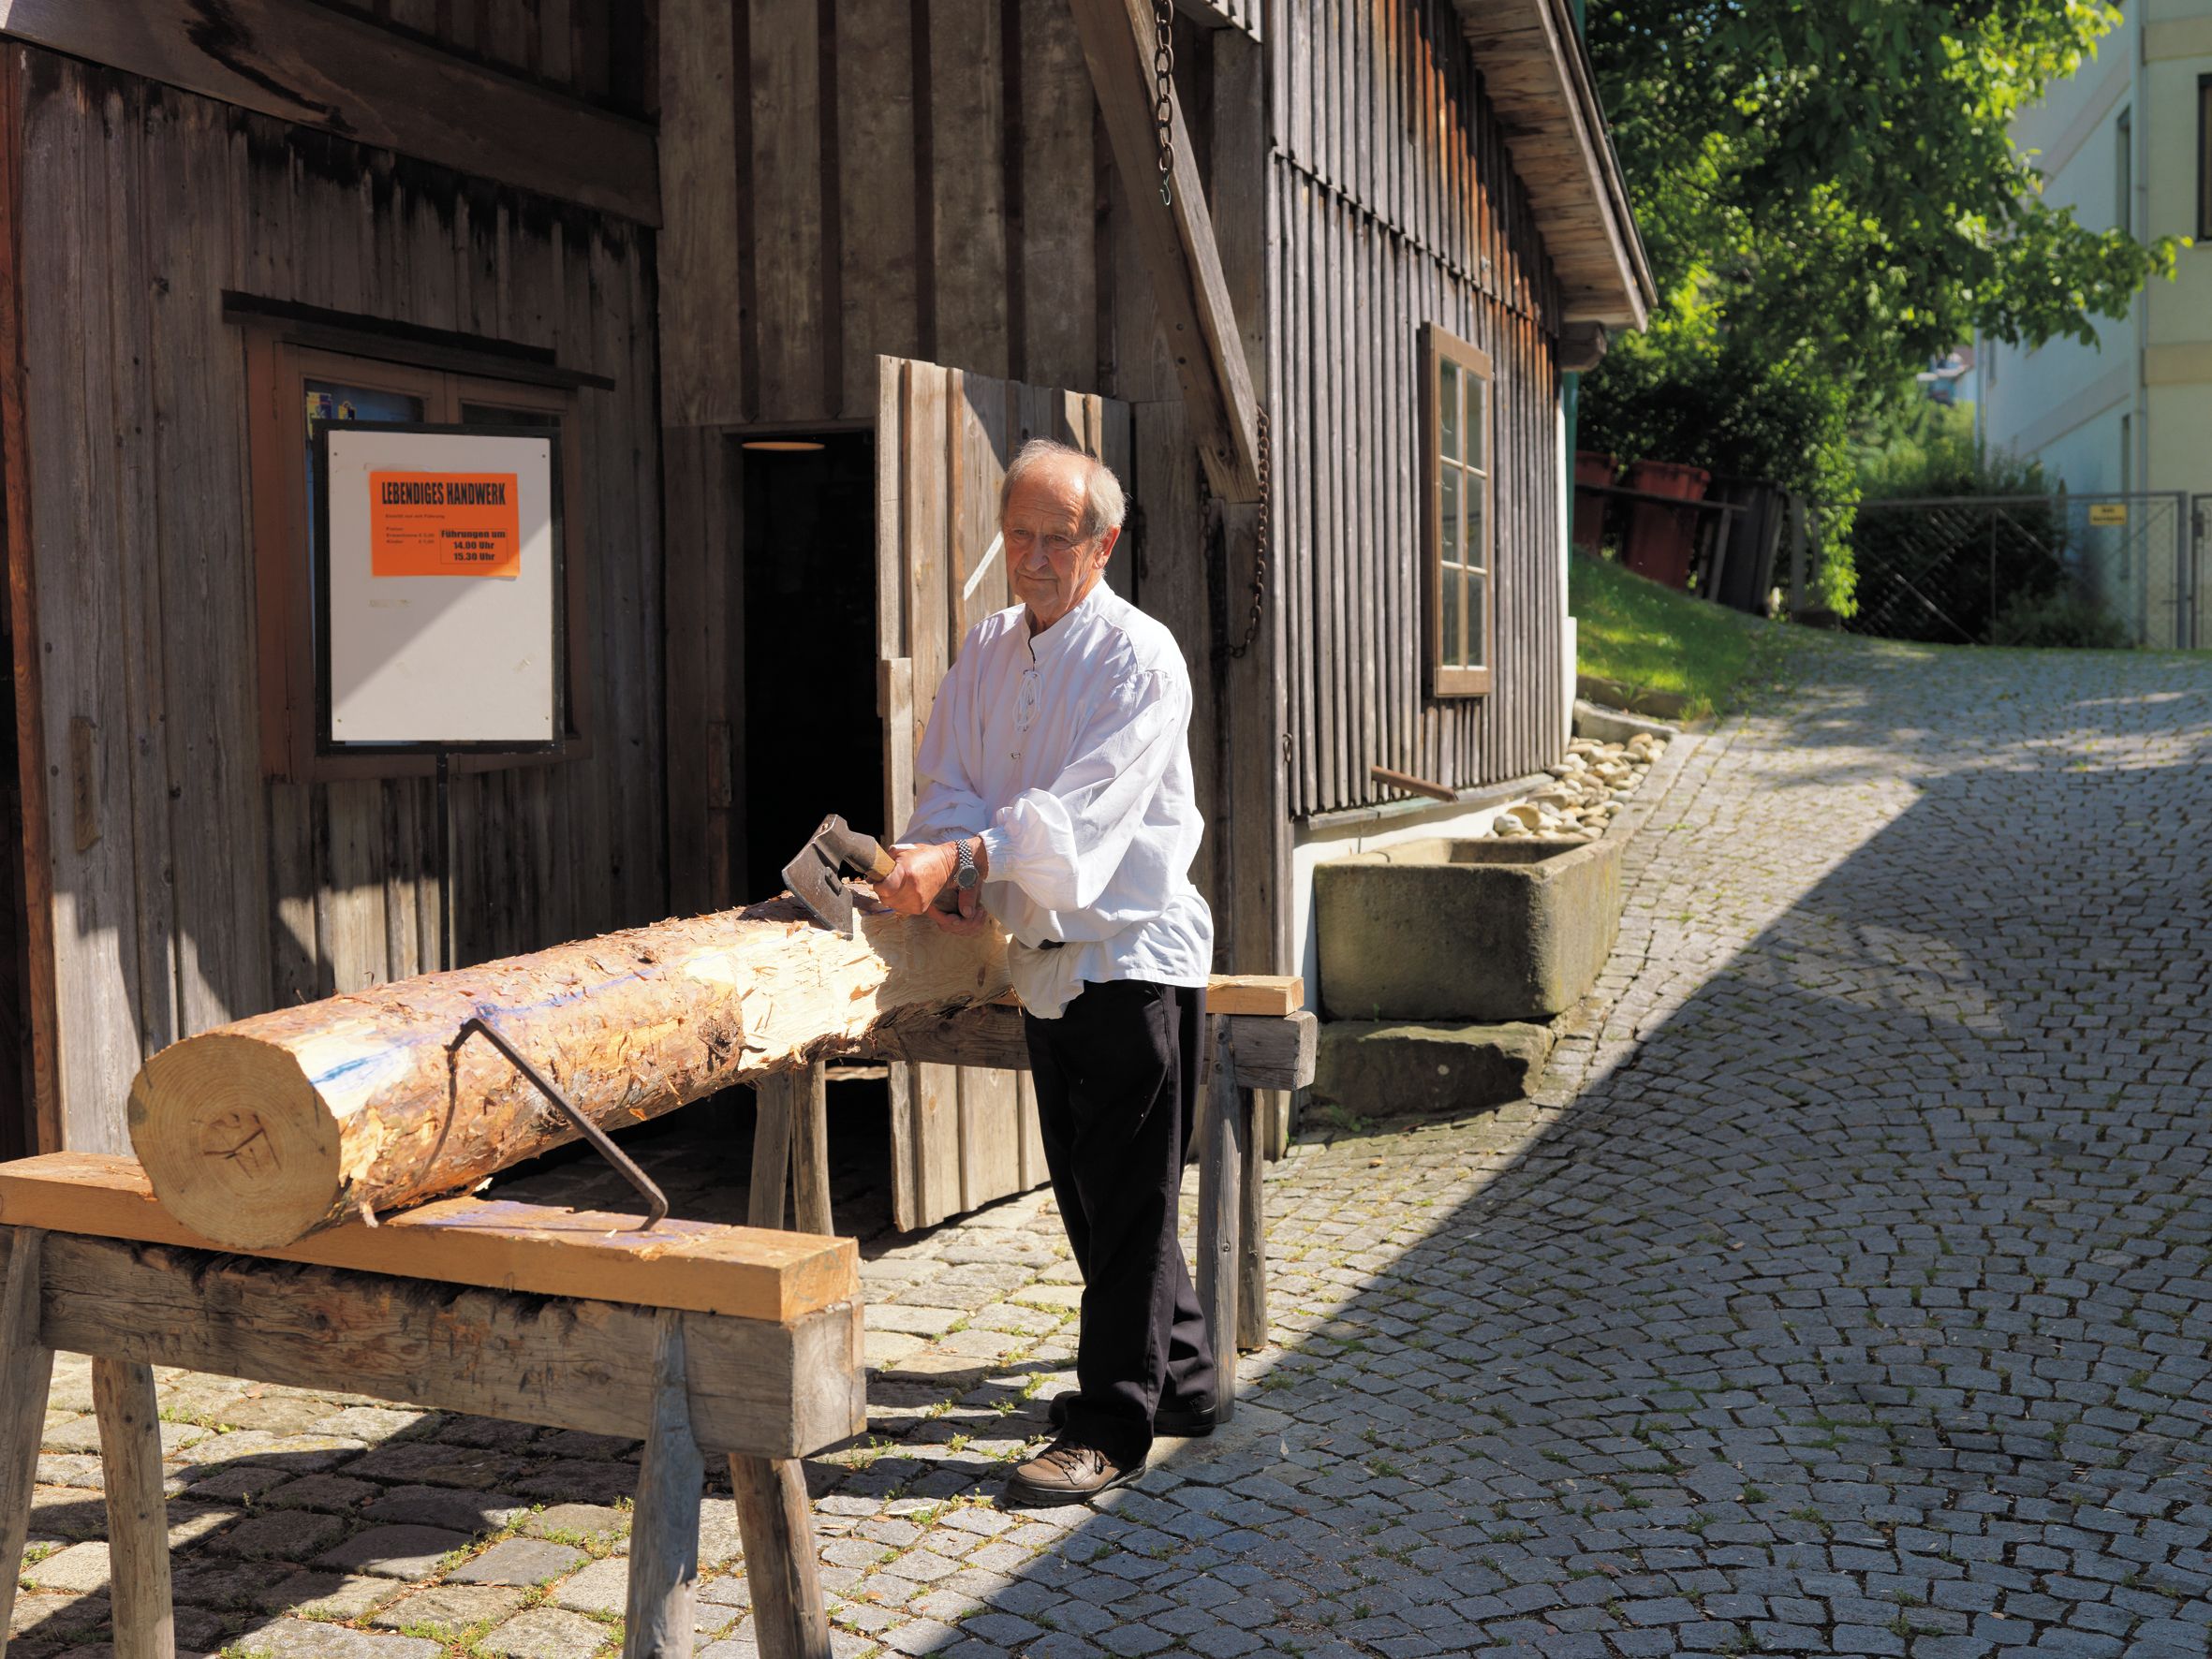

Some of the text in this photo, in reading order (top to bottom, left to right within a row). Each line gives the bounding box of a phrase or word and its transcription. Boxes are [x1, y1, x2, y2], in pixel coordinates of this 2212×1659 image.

[382, 482, 506, 506] LEBENDIGES HANDWERK
[441, 530, 490, 538] Führungen
